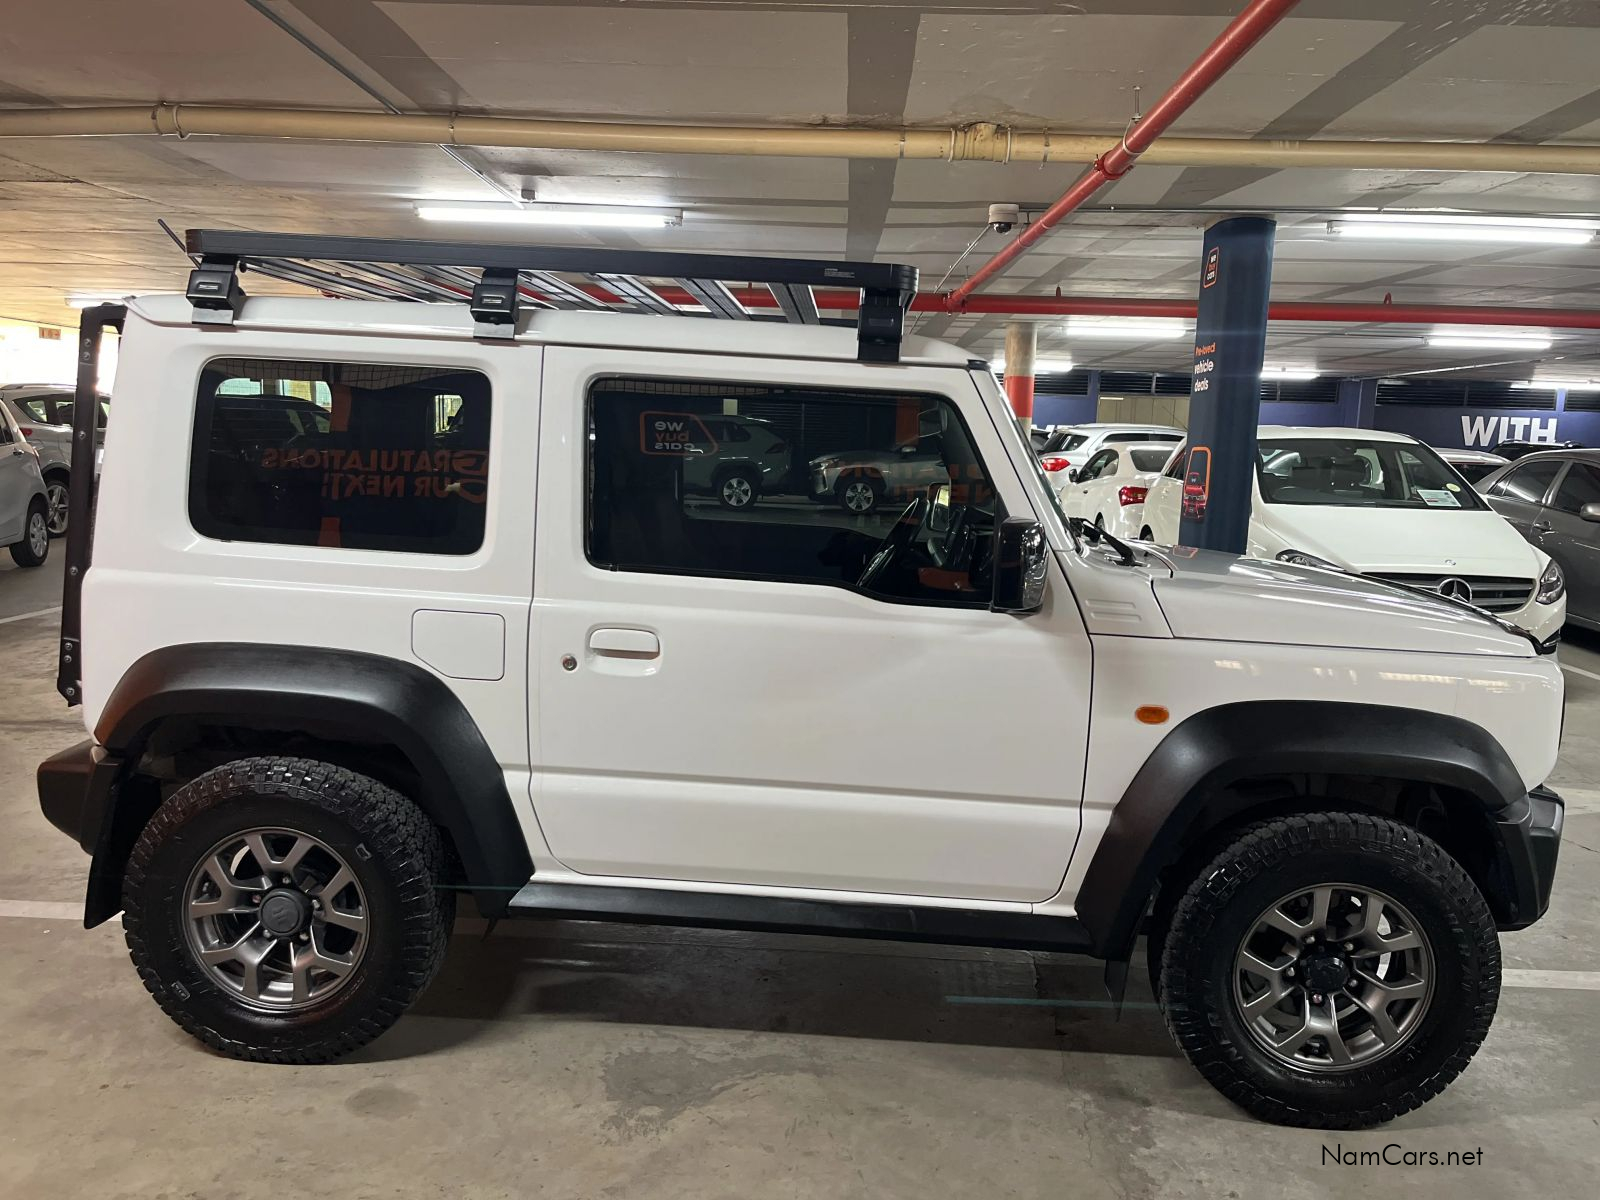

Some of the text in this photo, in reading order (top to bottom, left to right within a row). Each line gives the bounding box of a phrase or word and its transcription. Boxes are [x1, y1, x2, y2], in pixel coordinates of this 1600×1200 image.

[1194, 359, 1214, 374] vehicle
[1194, 377, 1209, 392] deals
[1461, 415, 1558, 447] WITH
